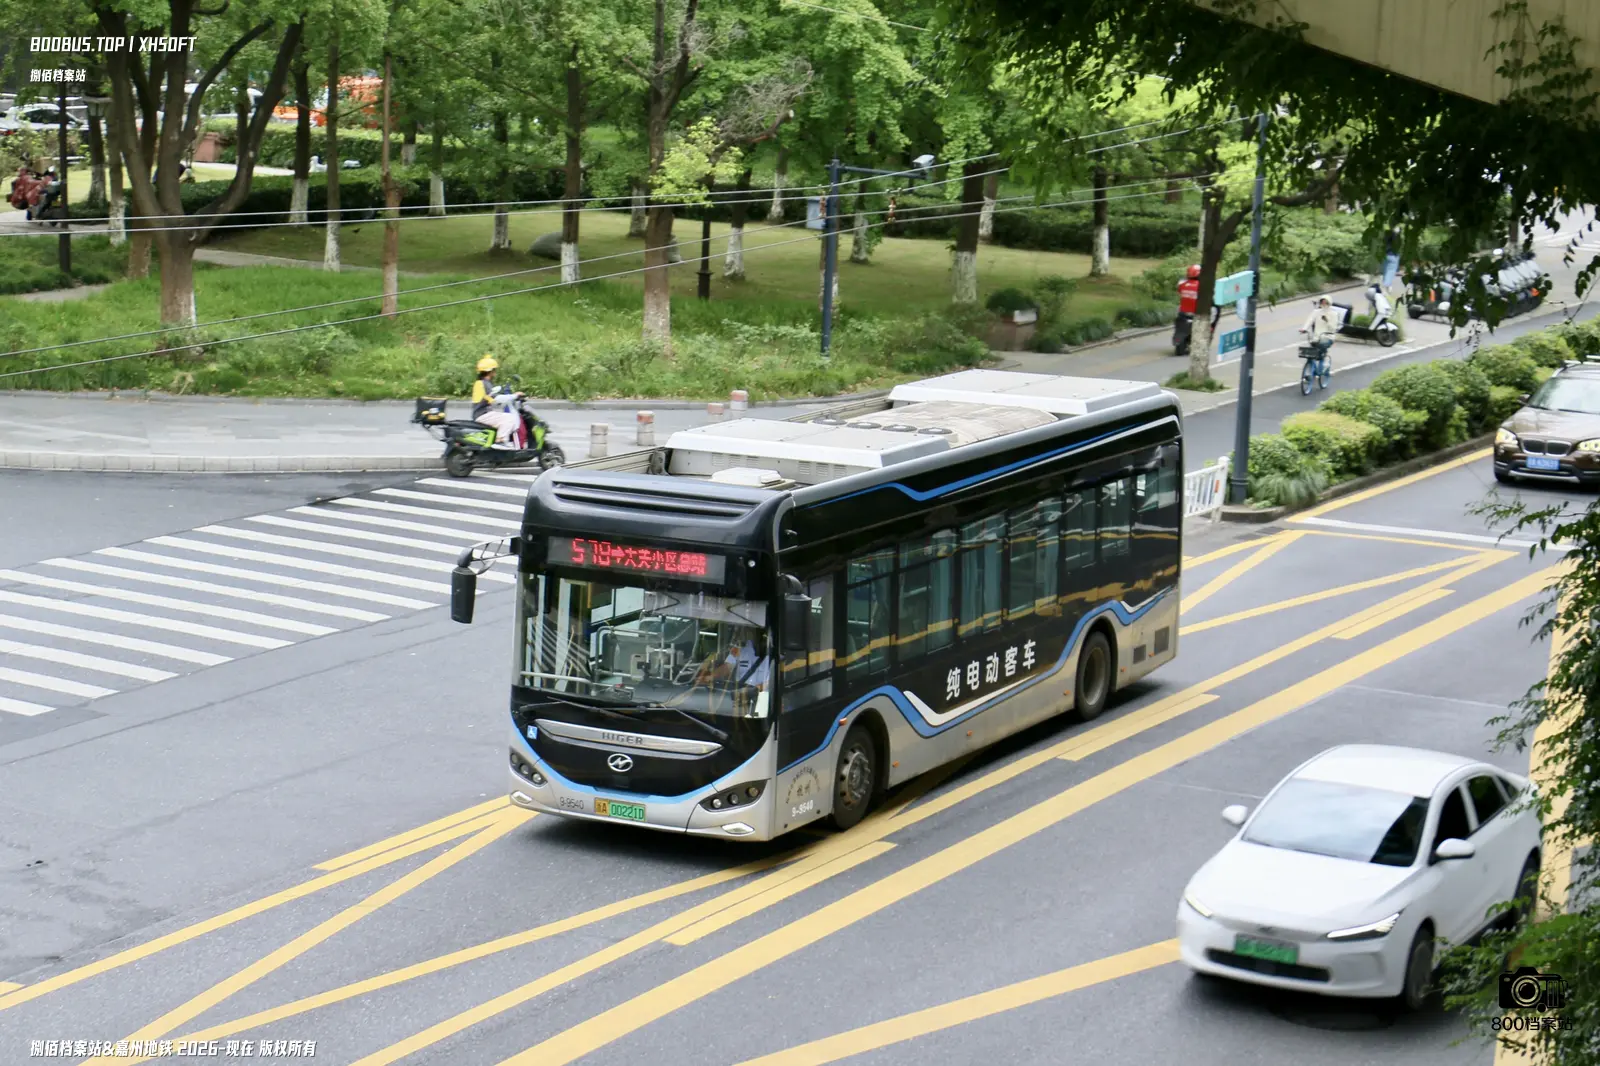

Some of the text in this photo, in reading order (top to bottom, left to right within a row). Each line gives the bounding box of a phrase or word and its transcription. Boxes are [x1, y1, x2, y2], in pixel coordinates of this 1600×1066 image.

[946, 639, 1037, 701] 纯电动客车
[602, 732, 644, 745] HIGER
